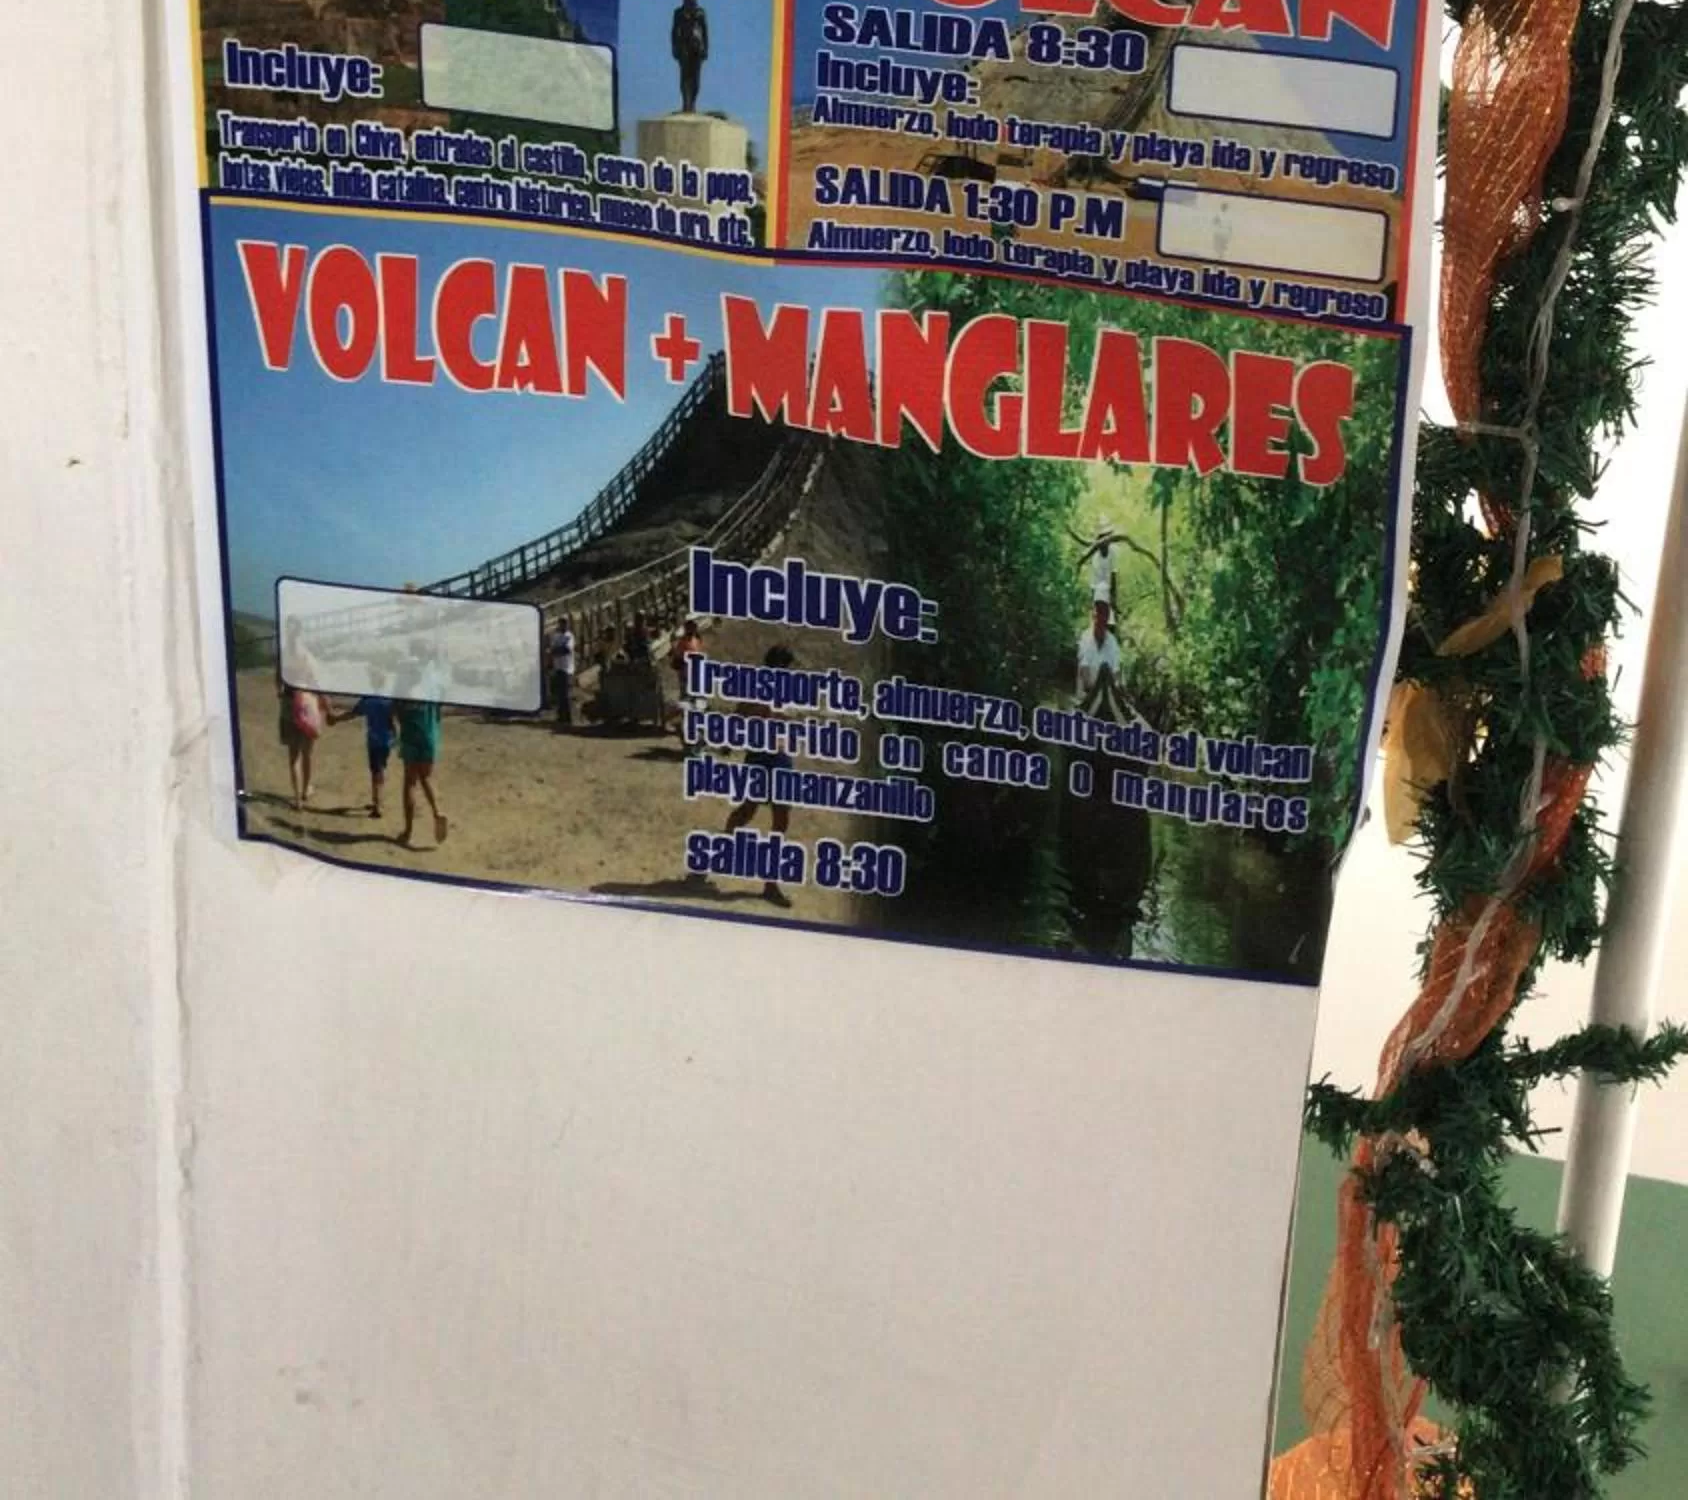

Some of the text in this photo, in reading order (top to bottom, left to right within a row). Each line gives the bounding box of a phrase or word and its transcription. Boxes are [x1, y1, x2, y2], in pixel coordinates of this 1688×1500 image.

[222, 40, 384, 101] Incluye:
[816, 50, 979, 105] Incluye:
[822, 4, 1147, 74] SALIDA 8:30
[812, 94, 1399, 193] Almuerzo, lodo terapia y playa ida y regreso
[814, 166, 1125, 241] SALIDA 1:30 P.M
[807, 220, 1386, 322] Almuerzo, lodo terapia y playa ida y regreso
[237, 238, 629, 403] VOLCAN
[721, 292, 1356, 487] MANGLARES
[689, 545, 938, 644] Incluye:
[685, 651, 1313, 784] Transporte, almuerzo, entrada al volcan
[685, 708, 1309, 833] recorrido en canoa o manglares
[685, 755, 935, 825] playa manzanillo
[686, 829, 907, 898] salida 8:30
